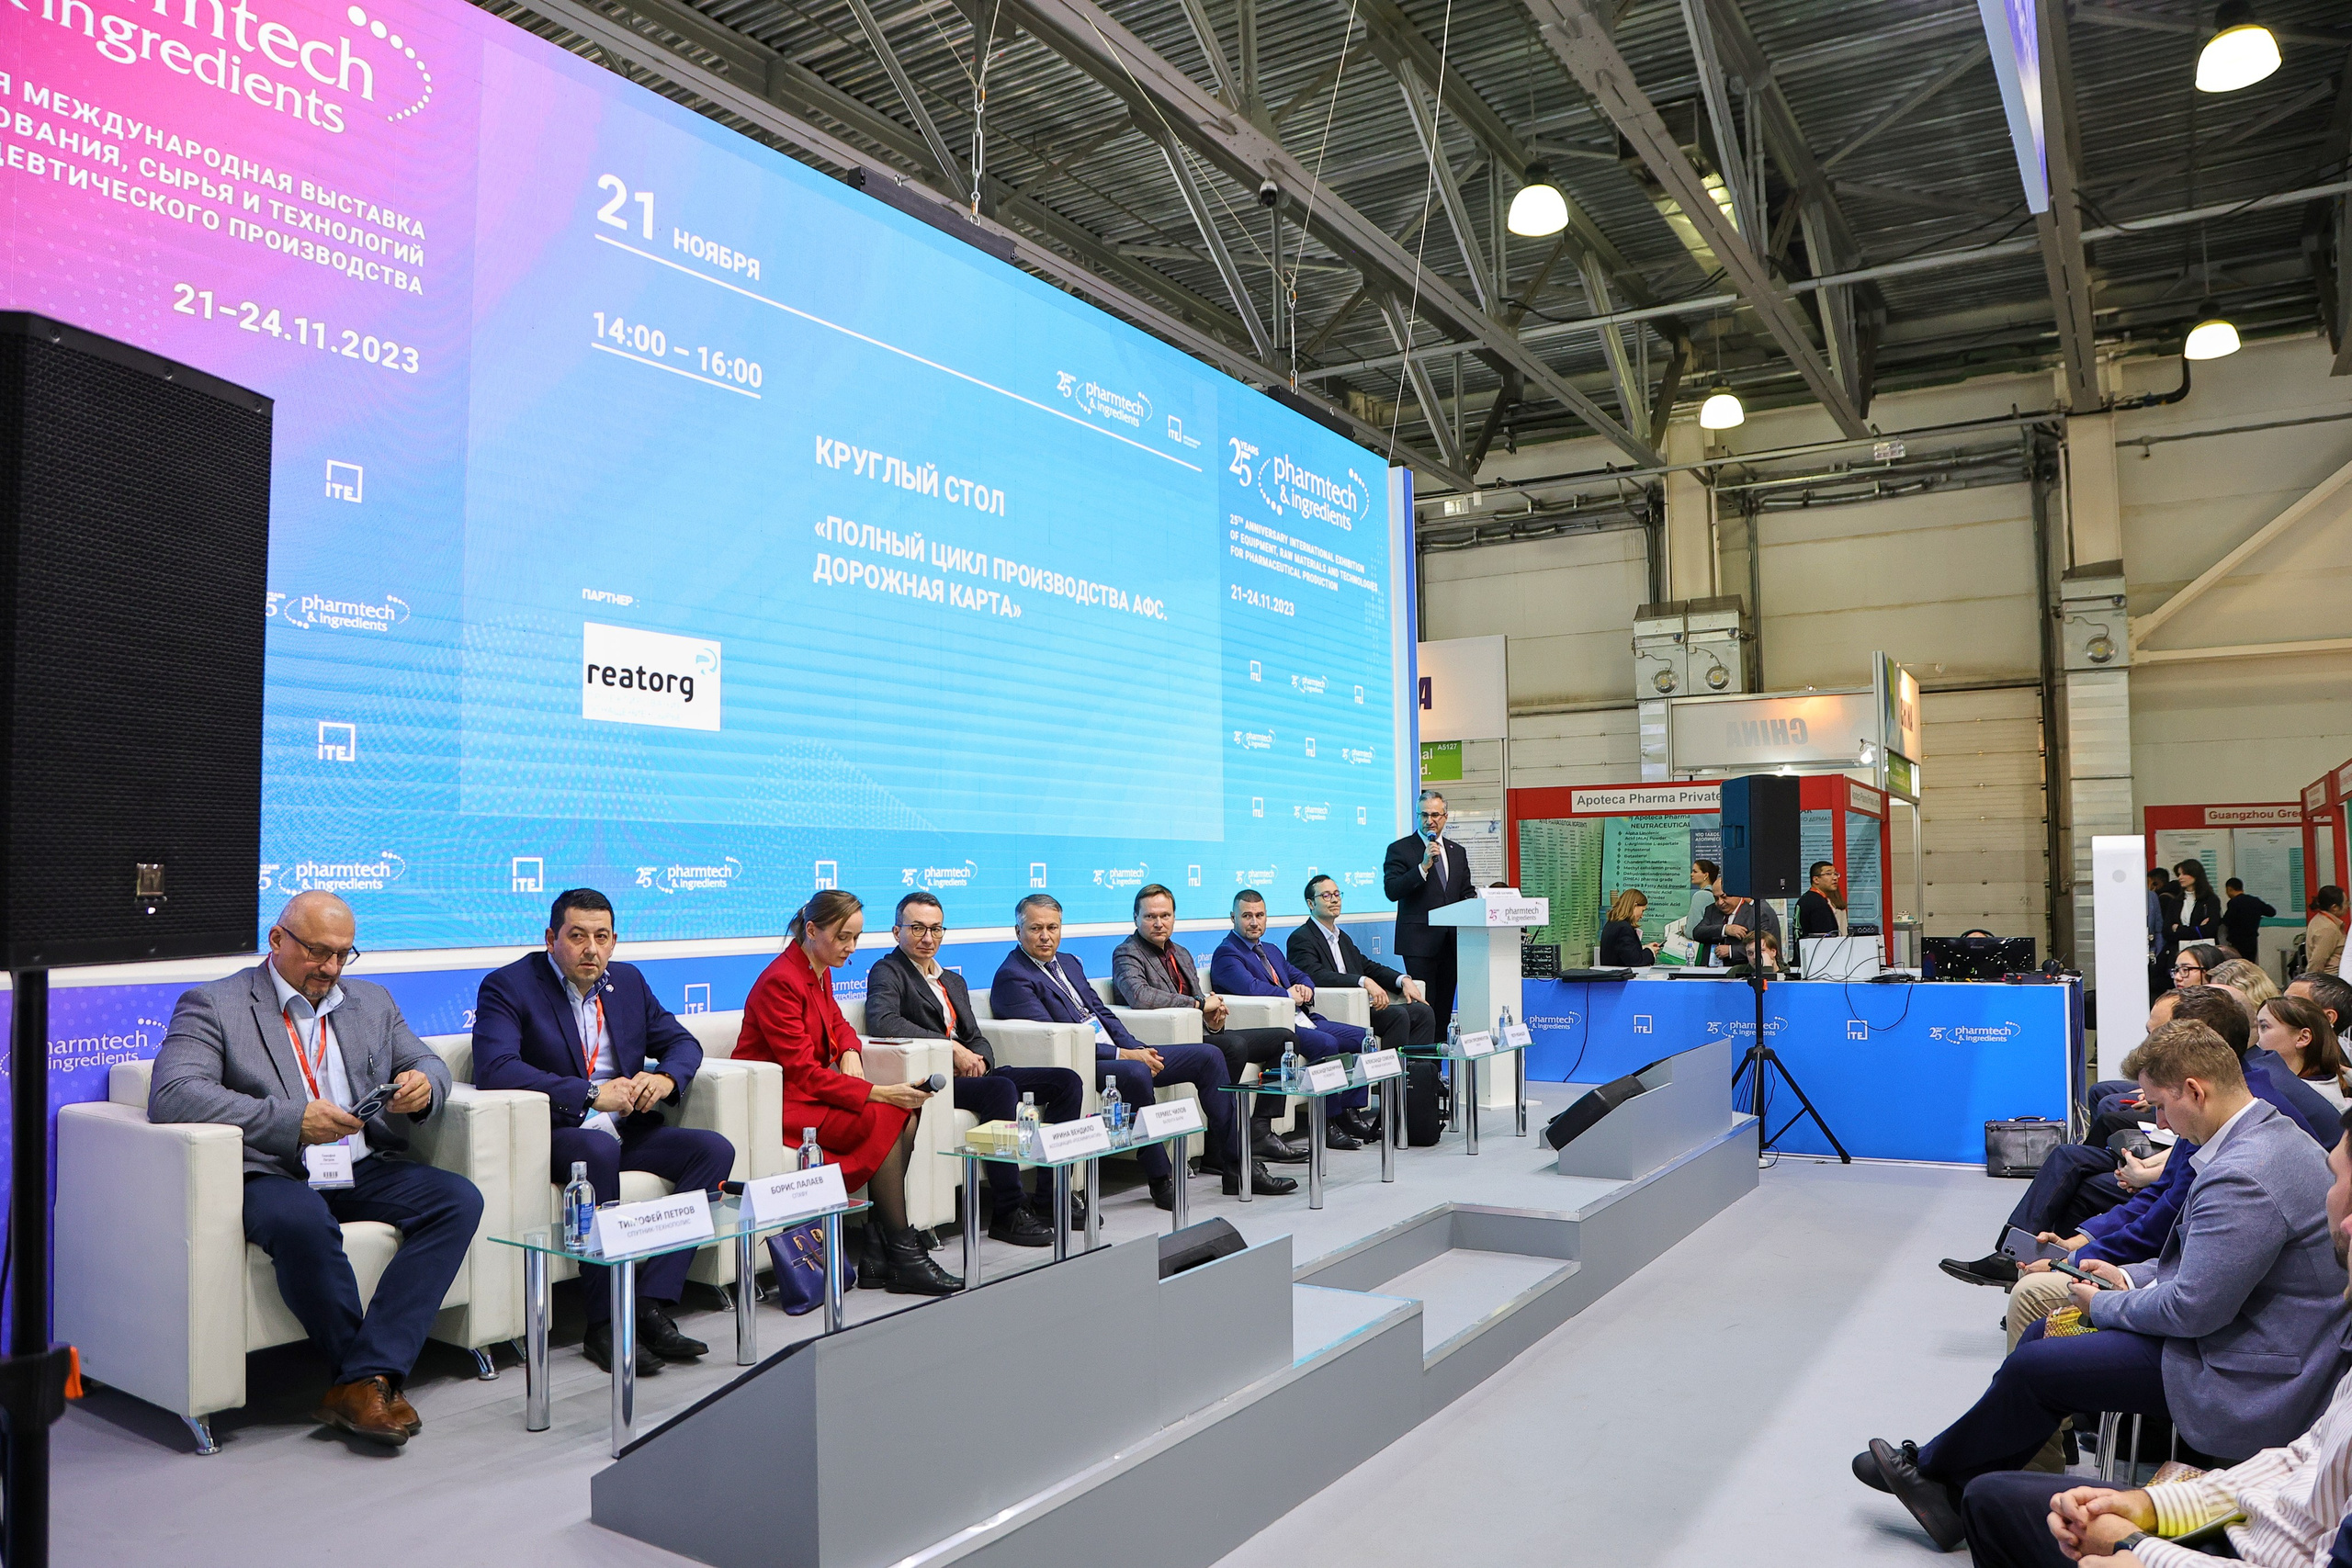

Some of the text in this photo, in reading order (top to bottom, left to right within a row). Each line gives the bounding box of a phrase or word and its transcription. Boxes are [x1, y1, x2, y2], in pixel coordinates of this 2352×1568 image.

[23, 81, 292, 194] МЕЖДУНАРОДНАЯ
[300, 181, 426, 240] ВЫСТАВКА
[0, 141, 424, 296] ЕВТИЧЕСКОГО ПРОИЗВОДСТВА
[139, 156, 233, 204] СЫРЬЯ
[243, 191, 259, 213] И
[268, 198, 424, 267] ТЕХНОЛОГИЙ
[597, 174, 761, 281] 21 НОЯБРЯ
[594, 311, 666, 357] 14:00
[697, 346, 763, 388] 16:00
[1057, 370, 1072, 399] 25
[1086, 381, 1145, 418] pharmtech
[1090, 397, 1140, 428] & ingredients
[1228, 436, 1260, 487] 25 YEARS
[815, 434, 1005, 517] КРУГЛЫЙ СТОЛ
[1273, 454, 1357, 513] pharmtech
[1280, 484, 1352, 532] & ingredients
[1245, 520, 1288, 545] ANNIVERSARY
[1289, 536, 1335, 563] INTERNATIONAL
[1335, 554, 1365, 574] EXHIBITION
[814, 514, 1168, 622] «ПОЛНЫЙ ЦИКЛ ПРОИЗВОДСТВА АФС.
[1229, 529, 1378, 592] OF EQUIPMENT, RAW MATERIALS AND TECHNOLOGIES
[1230, 545, 1339, 592] FOR PHARMACEUTICAL PRODUCTION
[813, 552, 1022, 619] ДОРОЖНАЯ КАРТА»
[266, 595, 278, 617] 5
[301, 594, 395, 621] pharmtech
[582, 588, 633, 606] ПАРТНЕР
[307, 611, 388, 632] & ingredients
[587, 663, 694, 703] reatorg
[1438, 743, 1457, 751] A5127
[1577, 795, 1625, 807] Apoteca
[1629, 793, 1676, 804] Pharma
[2209, 809, 2274, 820] Guangzhou
[258, 869, 272, 890] 5
[296, 861, 390, 881] pharmtech
[635, 867, 652, 888] 25
[667, 864, 732, 881] pharmtech
[924, 866, 970, 881] pharmtech
[1110, 868, 1144, 880] pharmtech
[301, 878, 383, 892] & ingredients
[672, 878, 727, 891] & ingredients
[933, 878, 967, 888] ingredients
[1505, 907, 1539, 917] pharmtech
[1530, 1014, 1574, 1026] pharmtech
[1538, 1022, 1570, 1031] ingredients
[1707, 1021, 1719, 1033] 25
[1729, 1019, 1780, 1032] pharmech
[1955, 1025, 2011, 1036] pharmtech
[1929, 1027, 1943, 1041] 25
[1965, 1034, 2007, 1043] ingredients
[1052, 1125, 1094, 1140] ИРИНА ВЕНДИЛО
[771, 1176, 823, 1194] БОРИС ЛАЛАЕВ
[664, 1206, 695, 1220] ПЕТРОВ
